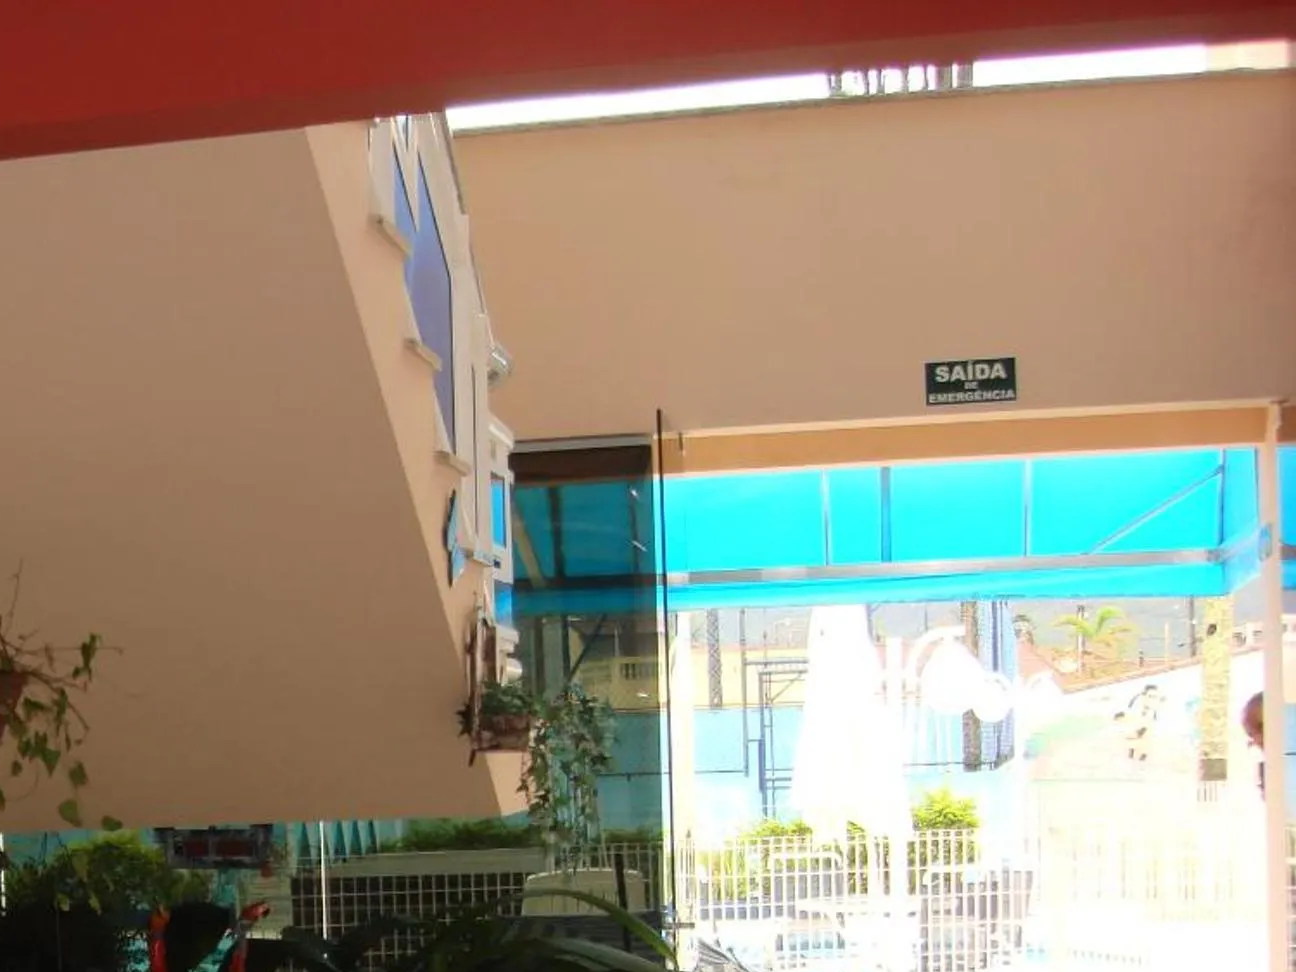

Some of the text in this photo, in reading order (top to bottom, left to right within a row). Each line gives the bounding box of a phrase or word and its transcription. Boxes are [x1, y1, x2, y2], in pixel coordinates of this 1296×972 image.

[935, 361, 1007, 382] SAÍDA
[964, 381, 979, 389] DE
[929, 389, 1015, 403] EMERGÊNCIA
